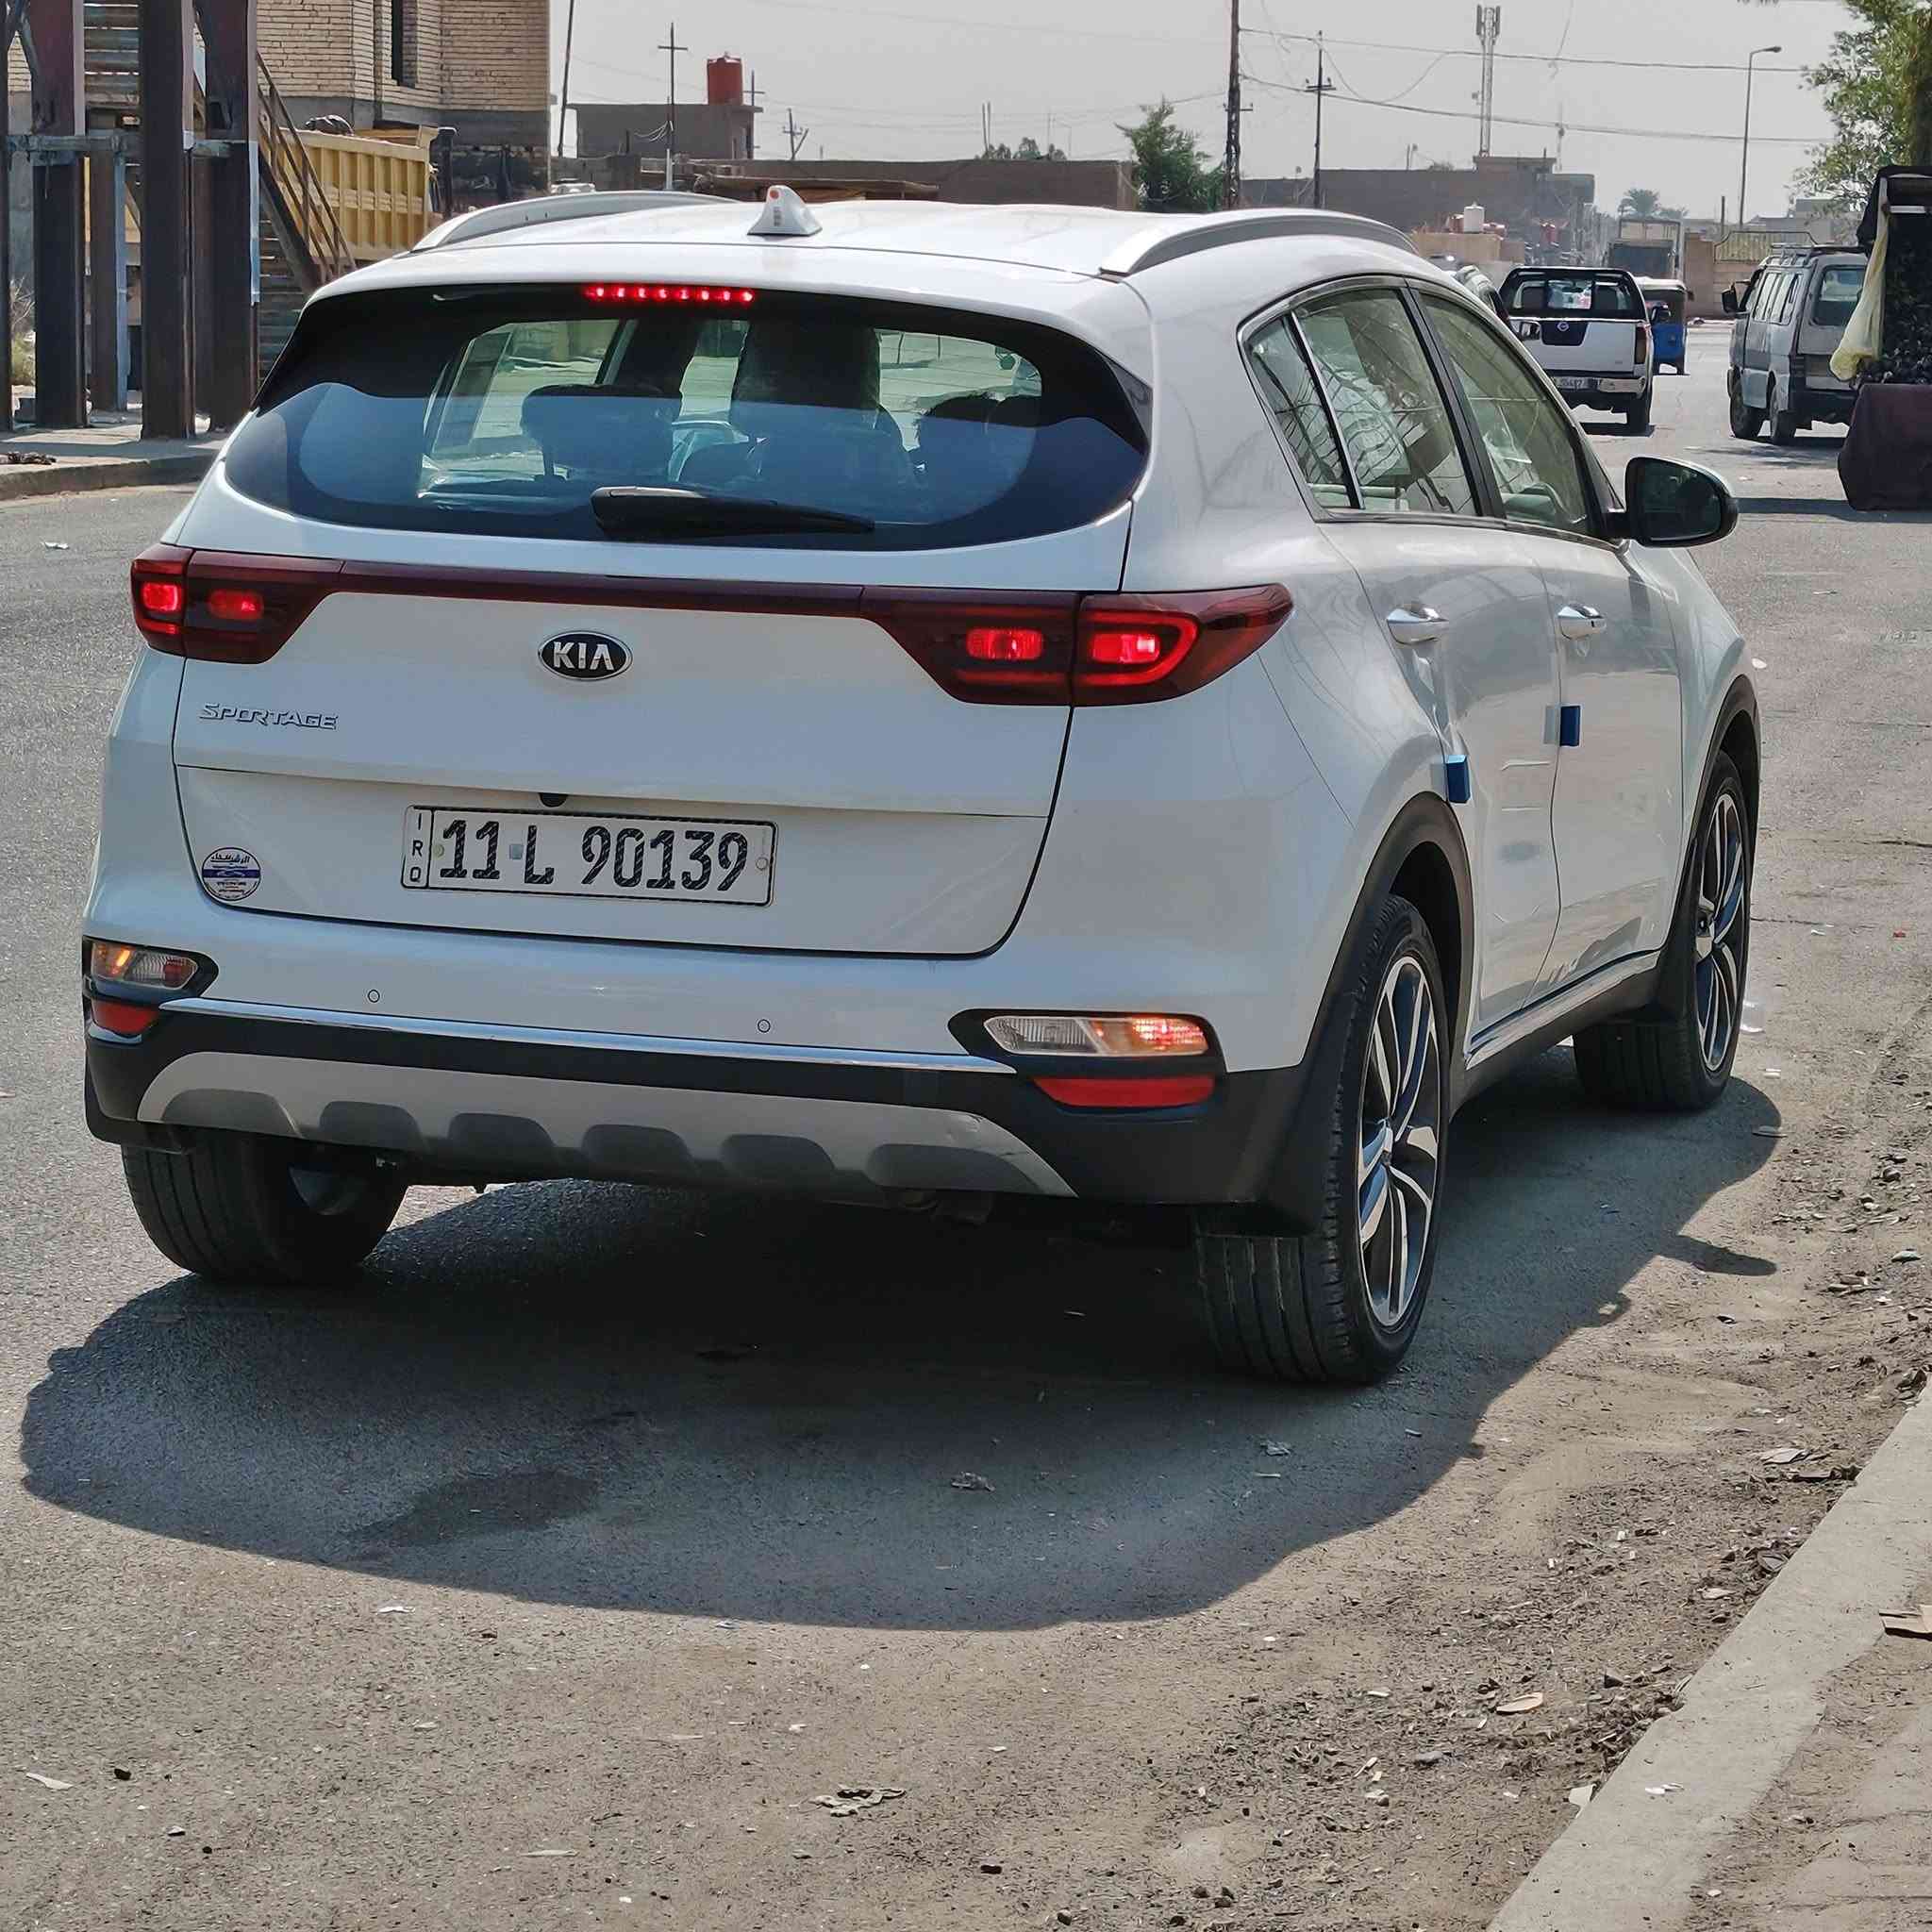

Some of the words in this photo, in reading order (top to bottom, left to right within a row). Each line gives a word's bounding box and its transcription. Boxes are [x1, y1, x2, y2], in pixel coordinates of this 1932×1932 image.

[553, 641, 615, 671] KIA
[199, 703, 339, 731] SPORTAGE
[440, 819, 500, 879] 11
[525, 824, 555, 884] L
[581, 825, 748, 891] 90139
